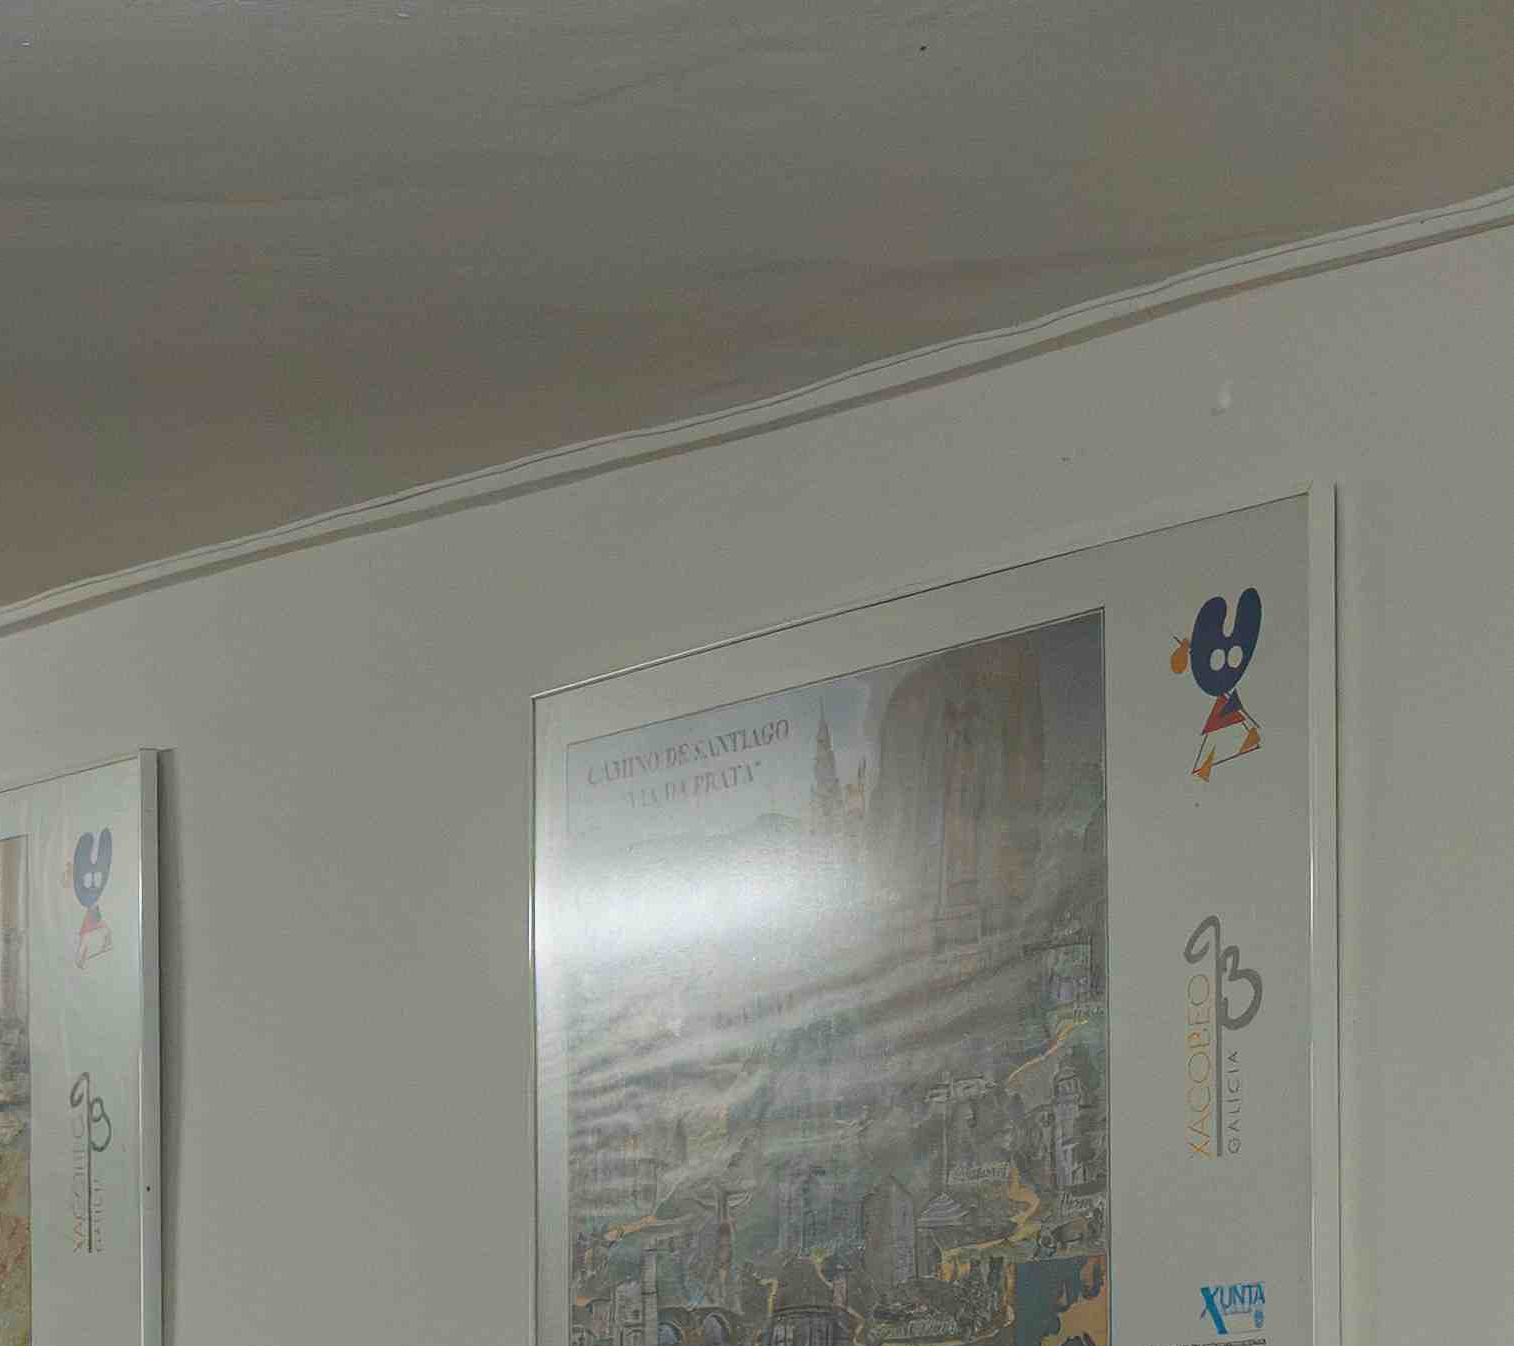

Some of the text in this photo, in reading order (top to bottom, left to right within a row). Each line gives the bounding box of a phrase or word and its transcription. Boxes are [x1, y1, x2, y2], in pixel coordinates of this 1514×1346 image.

[587, 718, 790, 785] CAMINO DE SANTIAGO
[1186, 973, 1211, 1157] XACOBEO
[1226, 1049, 1242, 1155] GALICIA
[1200, 1283, 1266, 1334] XUNTA
